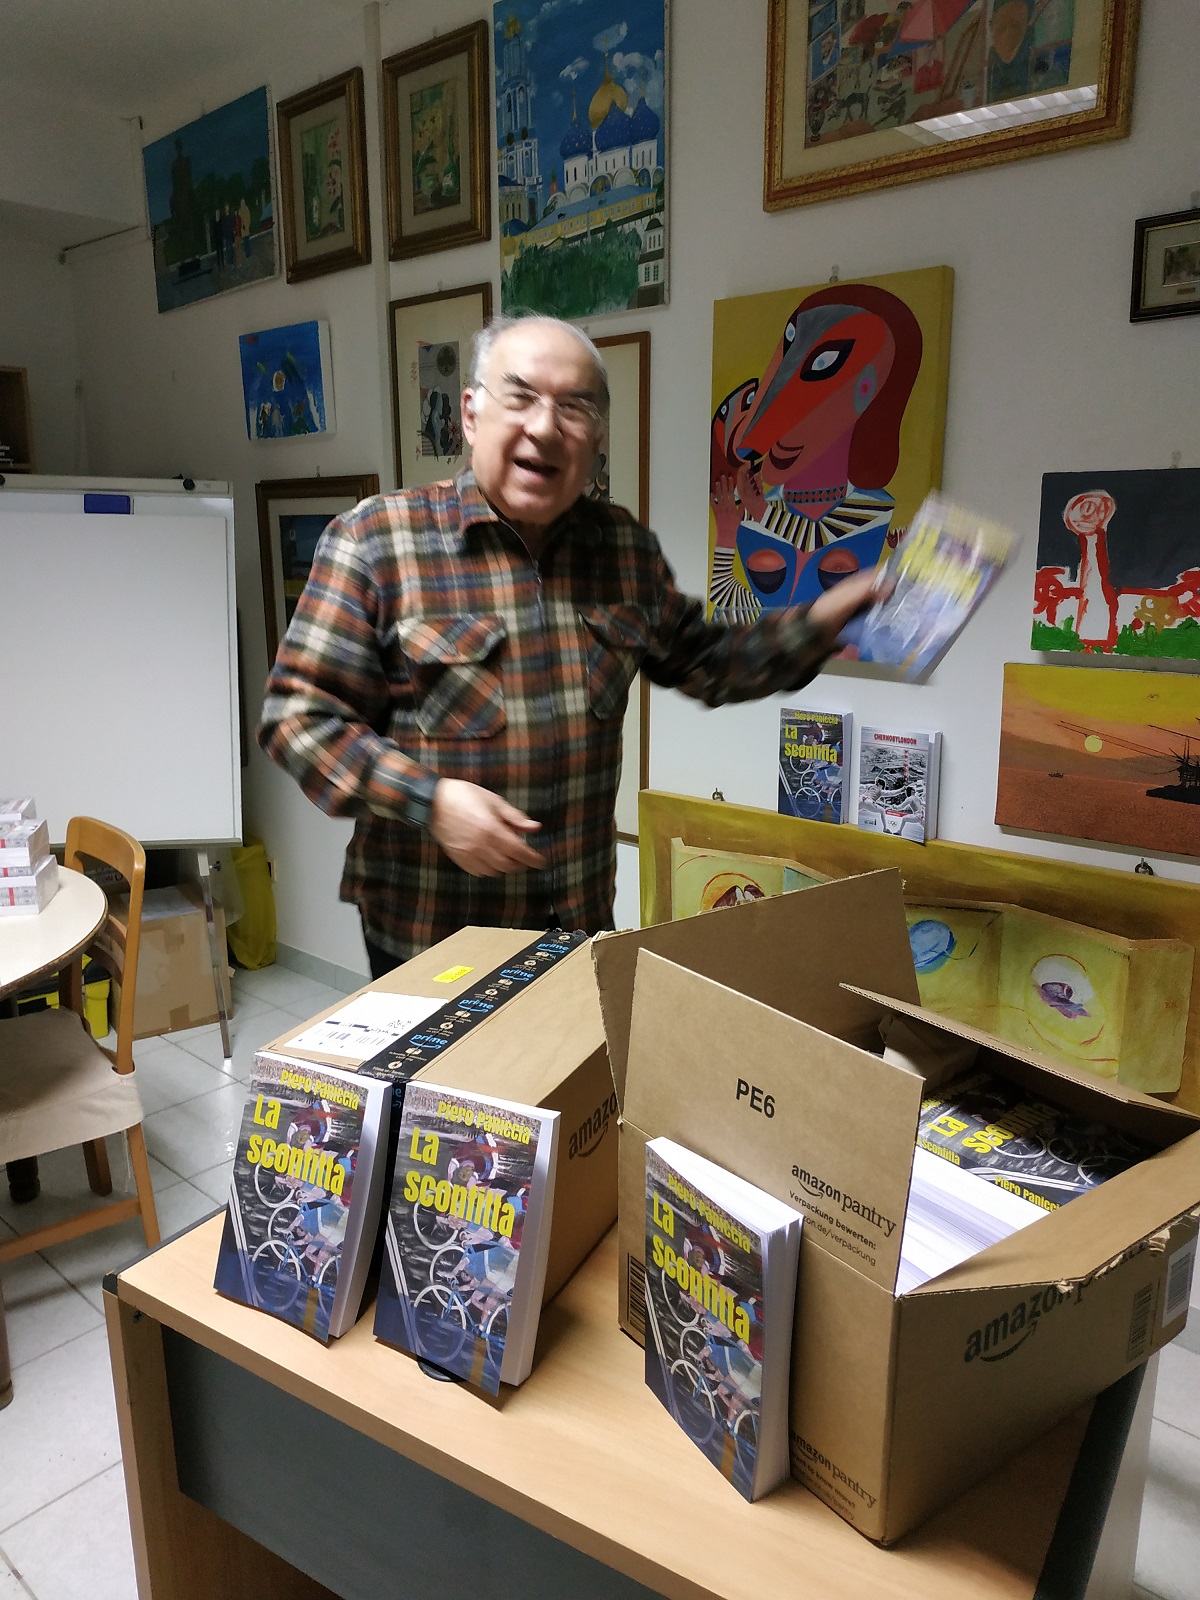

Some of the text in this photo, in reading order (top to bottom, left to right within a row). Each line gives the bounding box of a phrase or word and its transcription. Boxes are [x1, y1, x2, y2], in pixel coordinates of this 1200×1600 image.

[784, 724, 798, 740] La
[784, 742, 838, 763] sconfitta
[537, 943, 569, 952] prime
[500, 969, 535, 979] prime
[458, 999, 494, 1010] prime
[410, 1034, 448, 1045] prime
[279, 1069, 312, 1093] Piero
[313, 1078, 360, 1111] Paniccia
[735, 1077, 776, 1119] PE6
[253, 1093, 281, 1130] La
[437, 1101, 531, 1145] Piero Paniccia
[925, 1115, 969, 1138] La
[246, 1133, 346, 1197] sconfitta
[409, 1127, 440, 1166] La
[403, 1170, 516, 1239] sconfitta
[994, 1175, 1021, 1196] Piero
[653, 1191, 675, 1239] La
[667, 1173, 751, 1254] Piero Paniccia
[789, 1190, 877, 1250] Verpackung bewerten:
[652, 1235, 750, 1345] sconfitta
